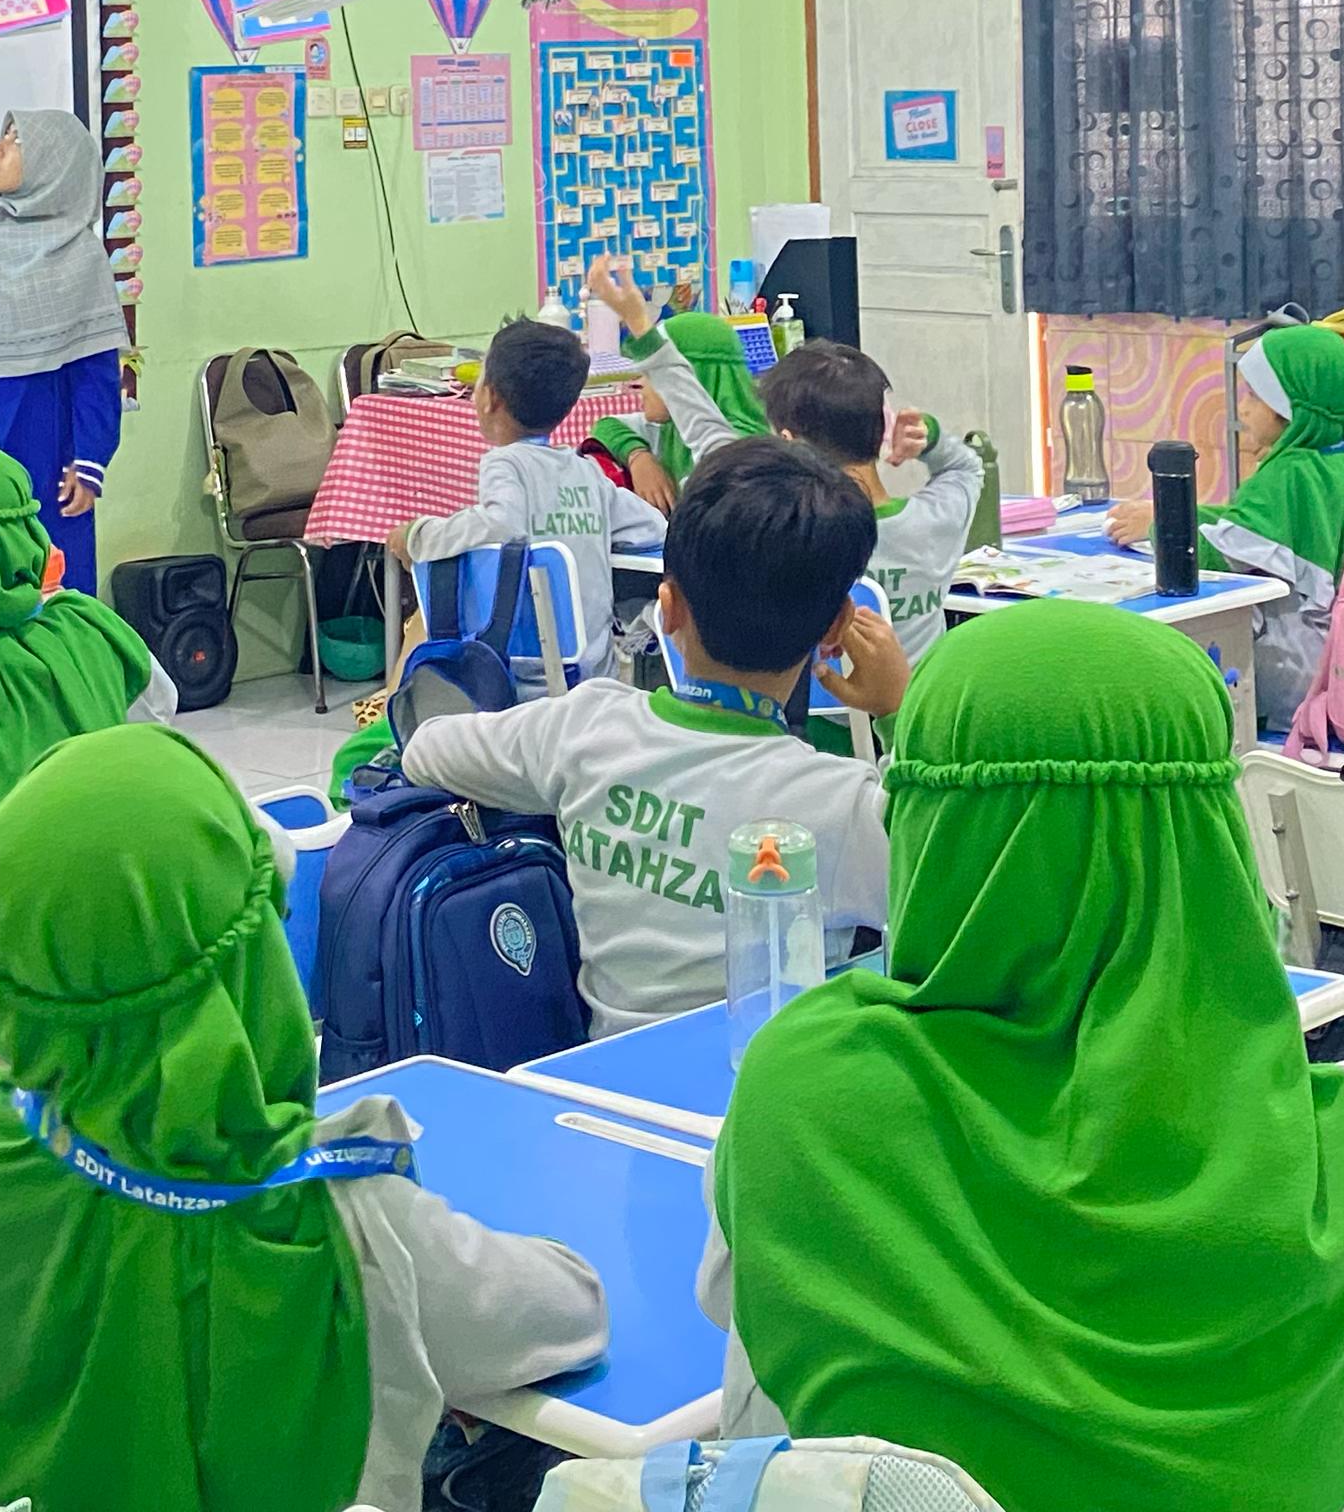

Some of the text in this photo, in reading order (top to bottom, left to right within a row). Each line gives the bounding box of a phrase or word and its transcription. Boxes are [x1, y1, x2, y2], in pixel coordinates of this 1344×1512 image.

[905, 118, 938, 133] CLOSE
[606, 784, 705, 848] SDIT
[568, 820, 724, 914] ATAHZA
[74, 1148, 116, 1187] SDIT
